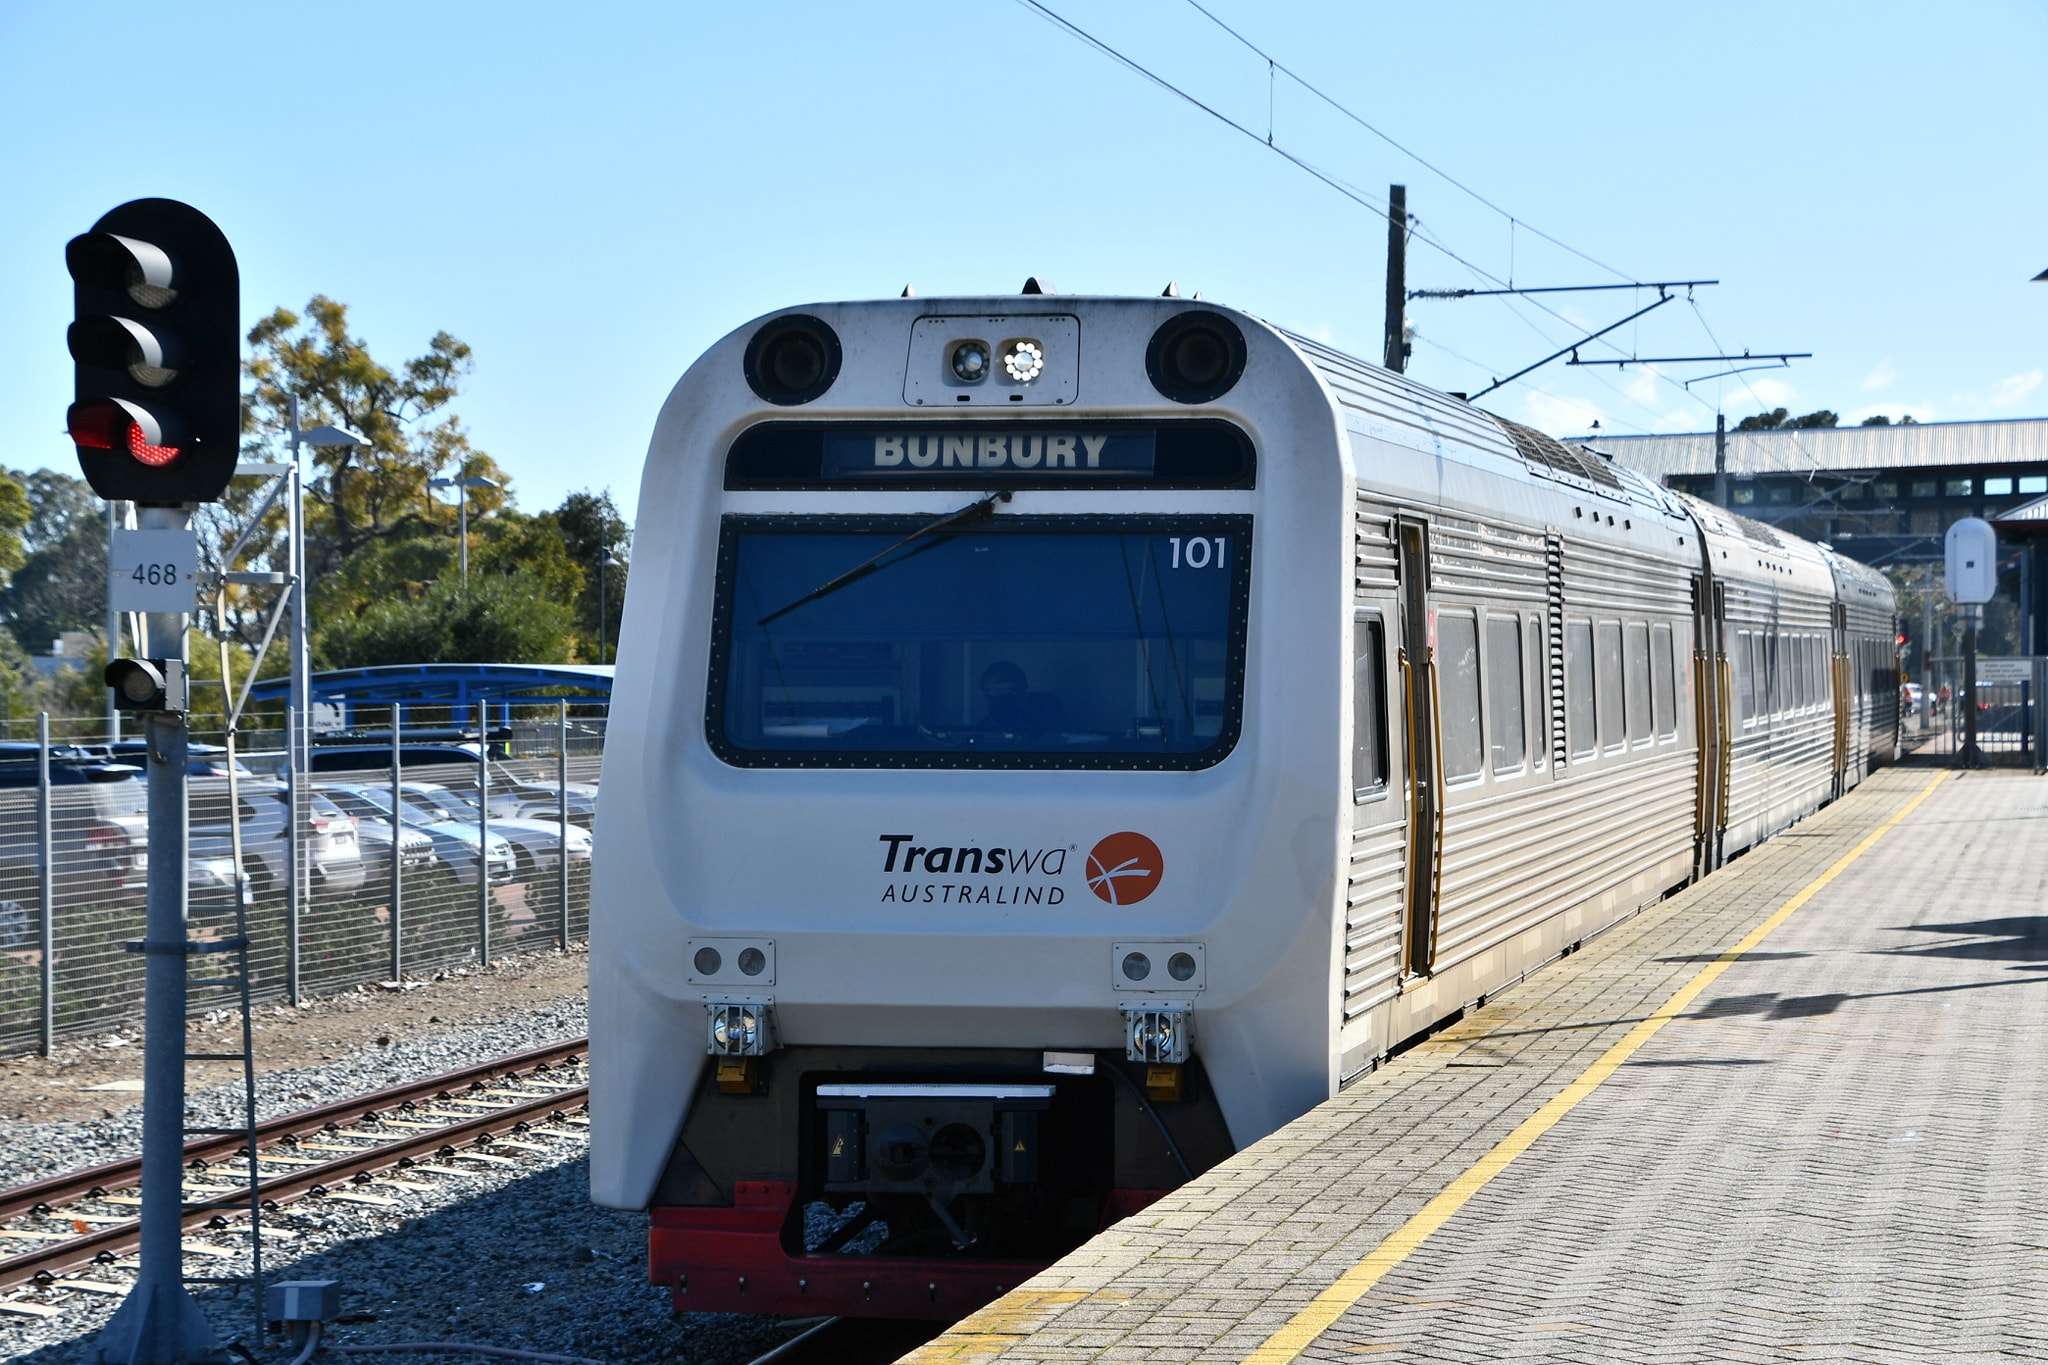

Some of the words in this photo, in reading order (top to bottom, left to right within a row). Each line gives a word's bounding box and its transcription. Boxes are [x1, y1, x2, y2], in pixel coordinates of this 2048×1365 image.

[874, 435, 1108, 468] BUNBURY
[1170, 537, 1226, 569] 101
[132, 563, 177, 585] 468
[882, 884, 1065, 905] AUSTRALIND
